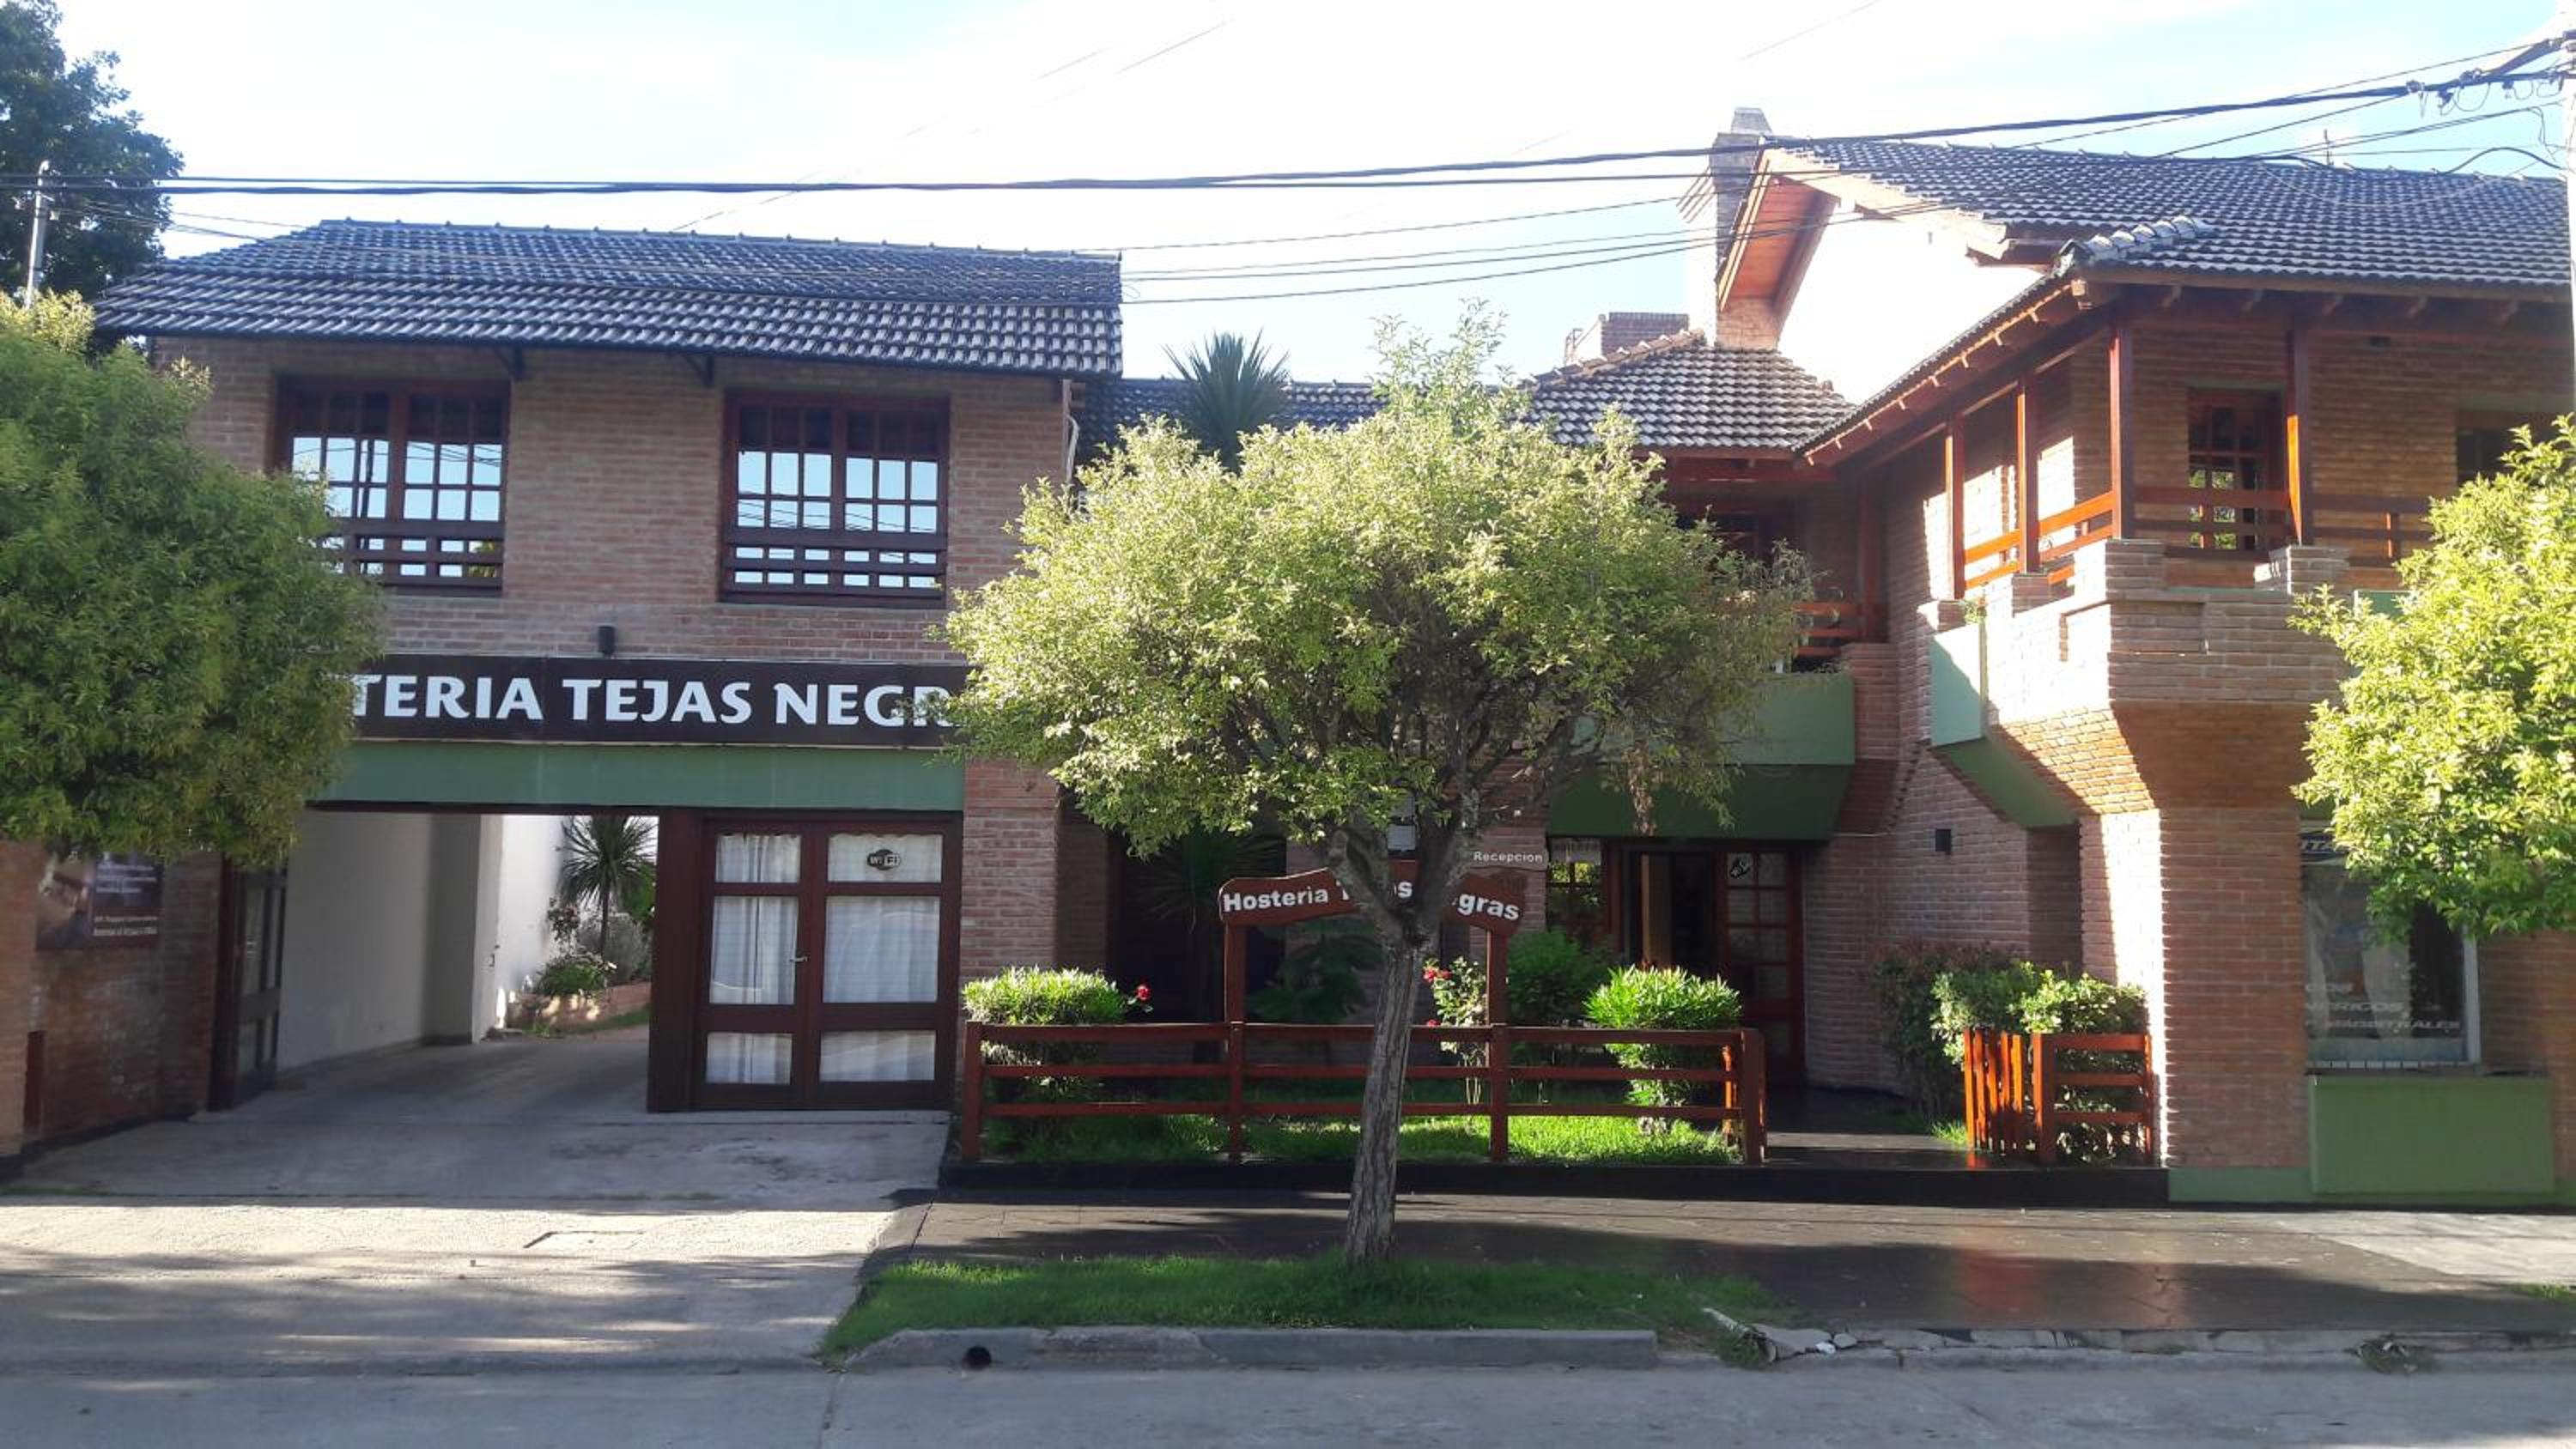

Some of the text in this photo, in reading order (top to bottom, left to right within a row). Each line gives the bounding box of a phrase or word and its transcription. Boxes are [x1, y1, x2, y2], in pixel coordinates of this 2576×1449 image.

[343, 674, 955, 727] TERIA TEJAS NEGR
[1223, 886, 1328, 912] Hosteria
[1457, 894, 1520, 921] gras
